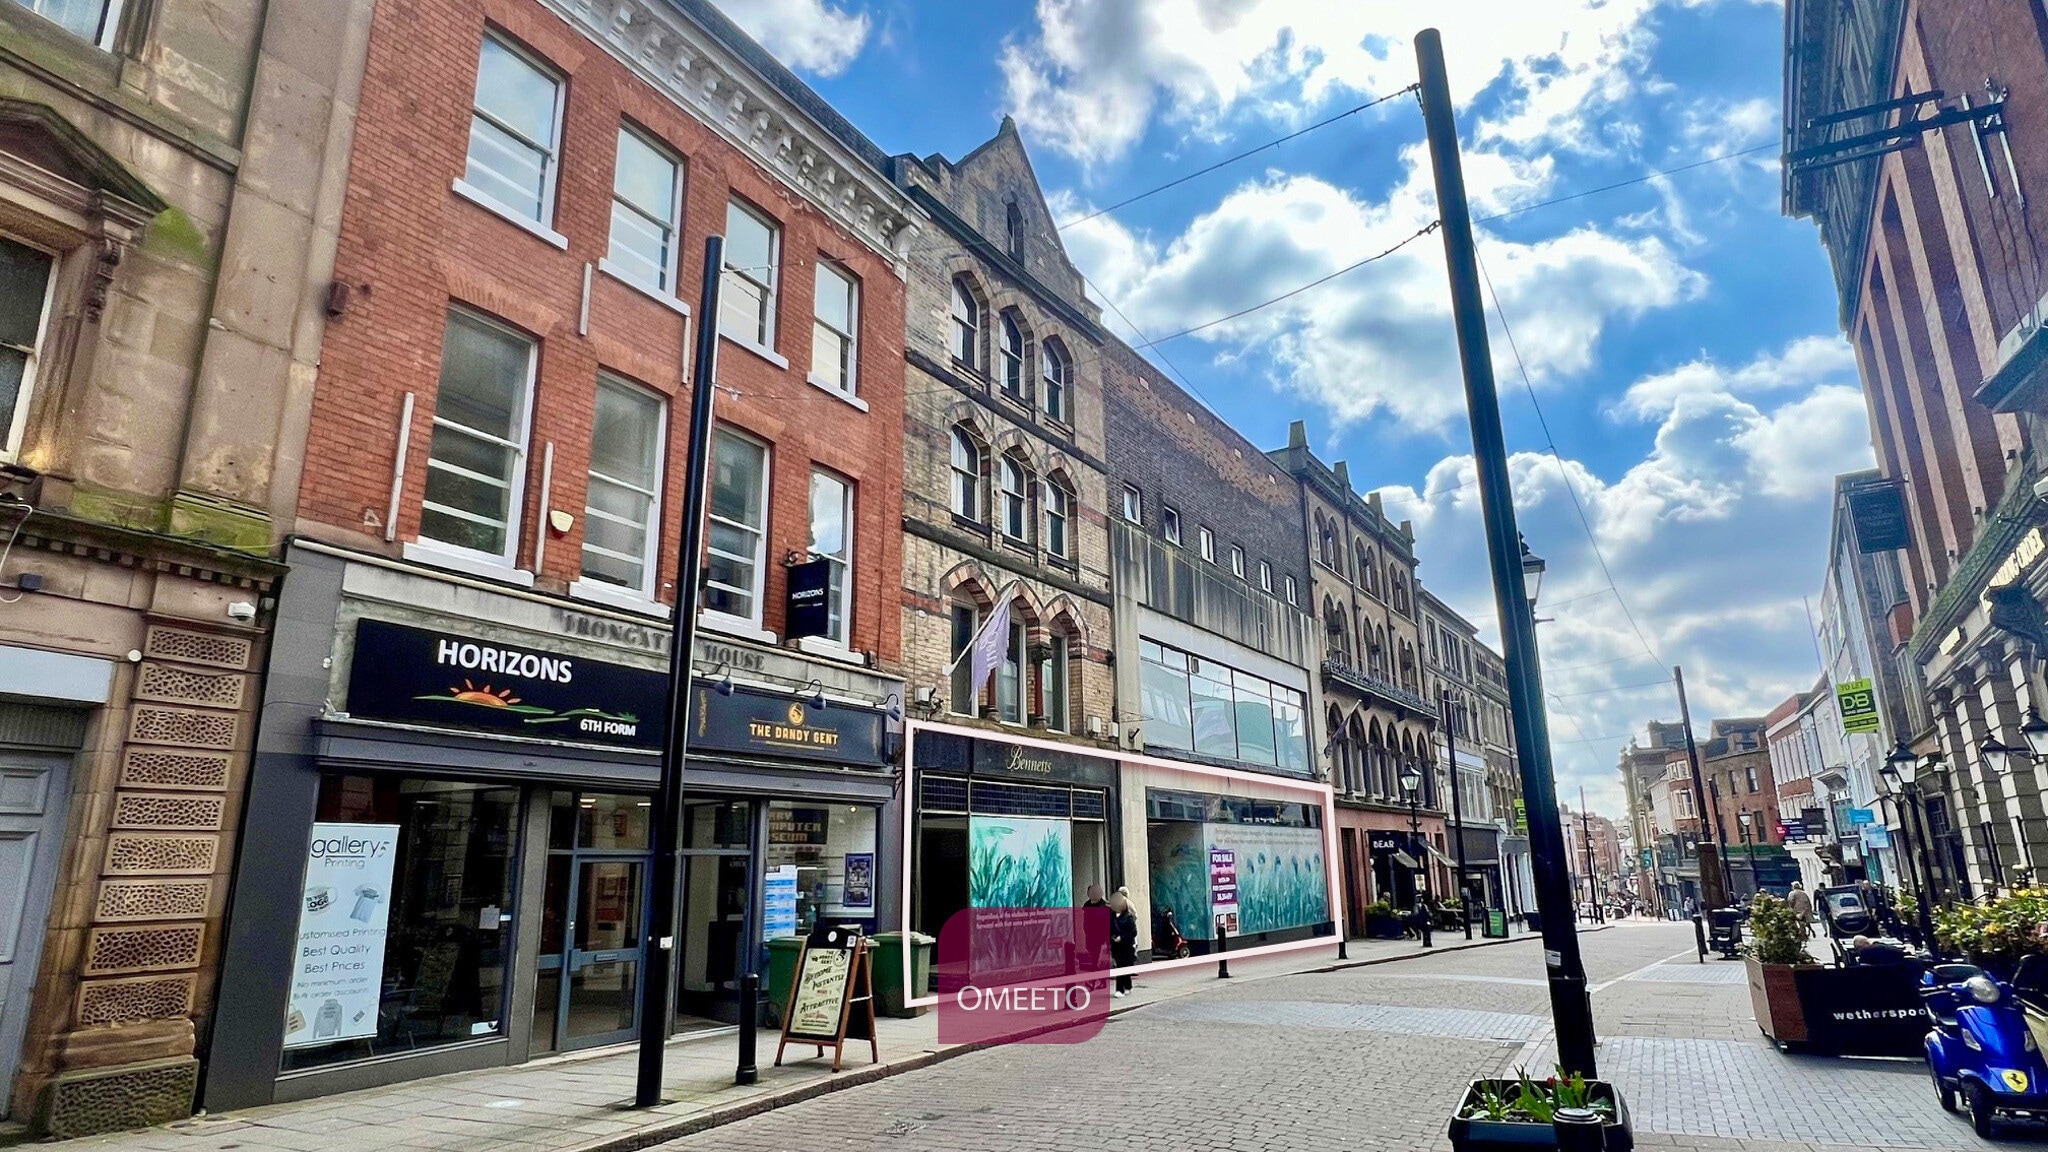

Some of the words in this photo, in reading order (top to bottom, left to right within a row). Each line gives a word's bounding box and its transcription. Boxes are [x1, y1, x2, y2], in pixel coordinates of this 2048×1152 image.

[437, 639, 573, 684] HORIZONS
[704, 644, 766, 671] HOUSE
[1851, 681, 1863, 689] LET
[1841, 692, 1869, 710] DB
[580, 718, 602, 733] 6TH
[603, 721, 636, 737] FORM
[750, 723, 771, 738] THE
[775, 726, 810, 742] DANDY
[813, 731, 839, 746] GENT
[1006, 744, 1052, 774] Bennetts
[1373, 840, 1395, 848] BEAR
[324, 858, 365, 869] Printing
[1212, 853, 1221, 863] FOR
[1222, 853, 1233, 863] SALE
[300, 930, 349, 940] ustomised
[352, 928, 386, 938] Printing
[303, 946, 327, 957] Best
[330, 944, 370, 956] Quality
[304, 963, 328, 974] Best
[332, 961, 365, 971] Prices
[311, 978, 347, 987] minimum
[1833, 1008, 1927, 1020] wetherspoo
